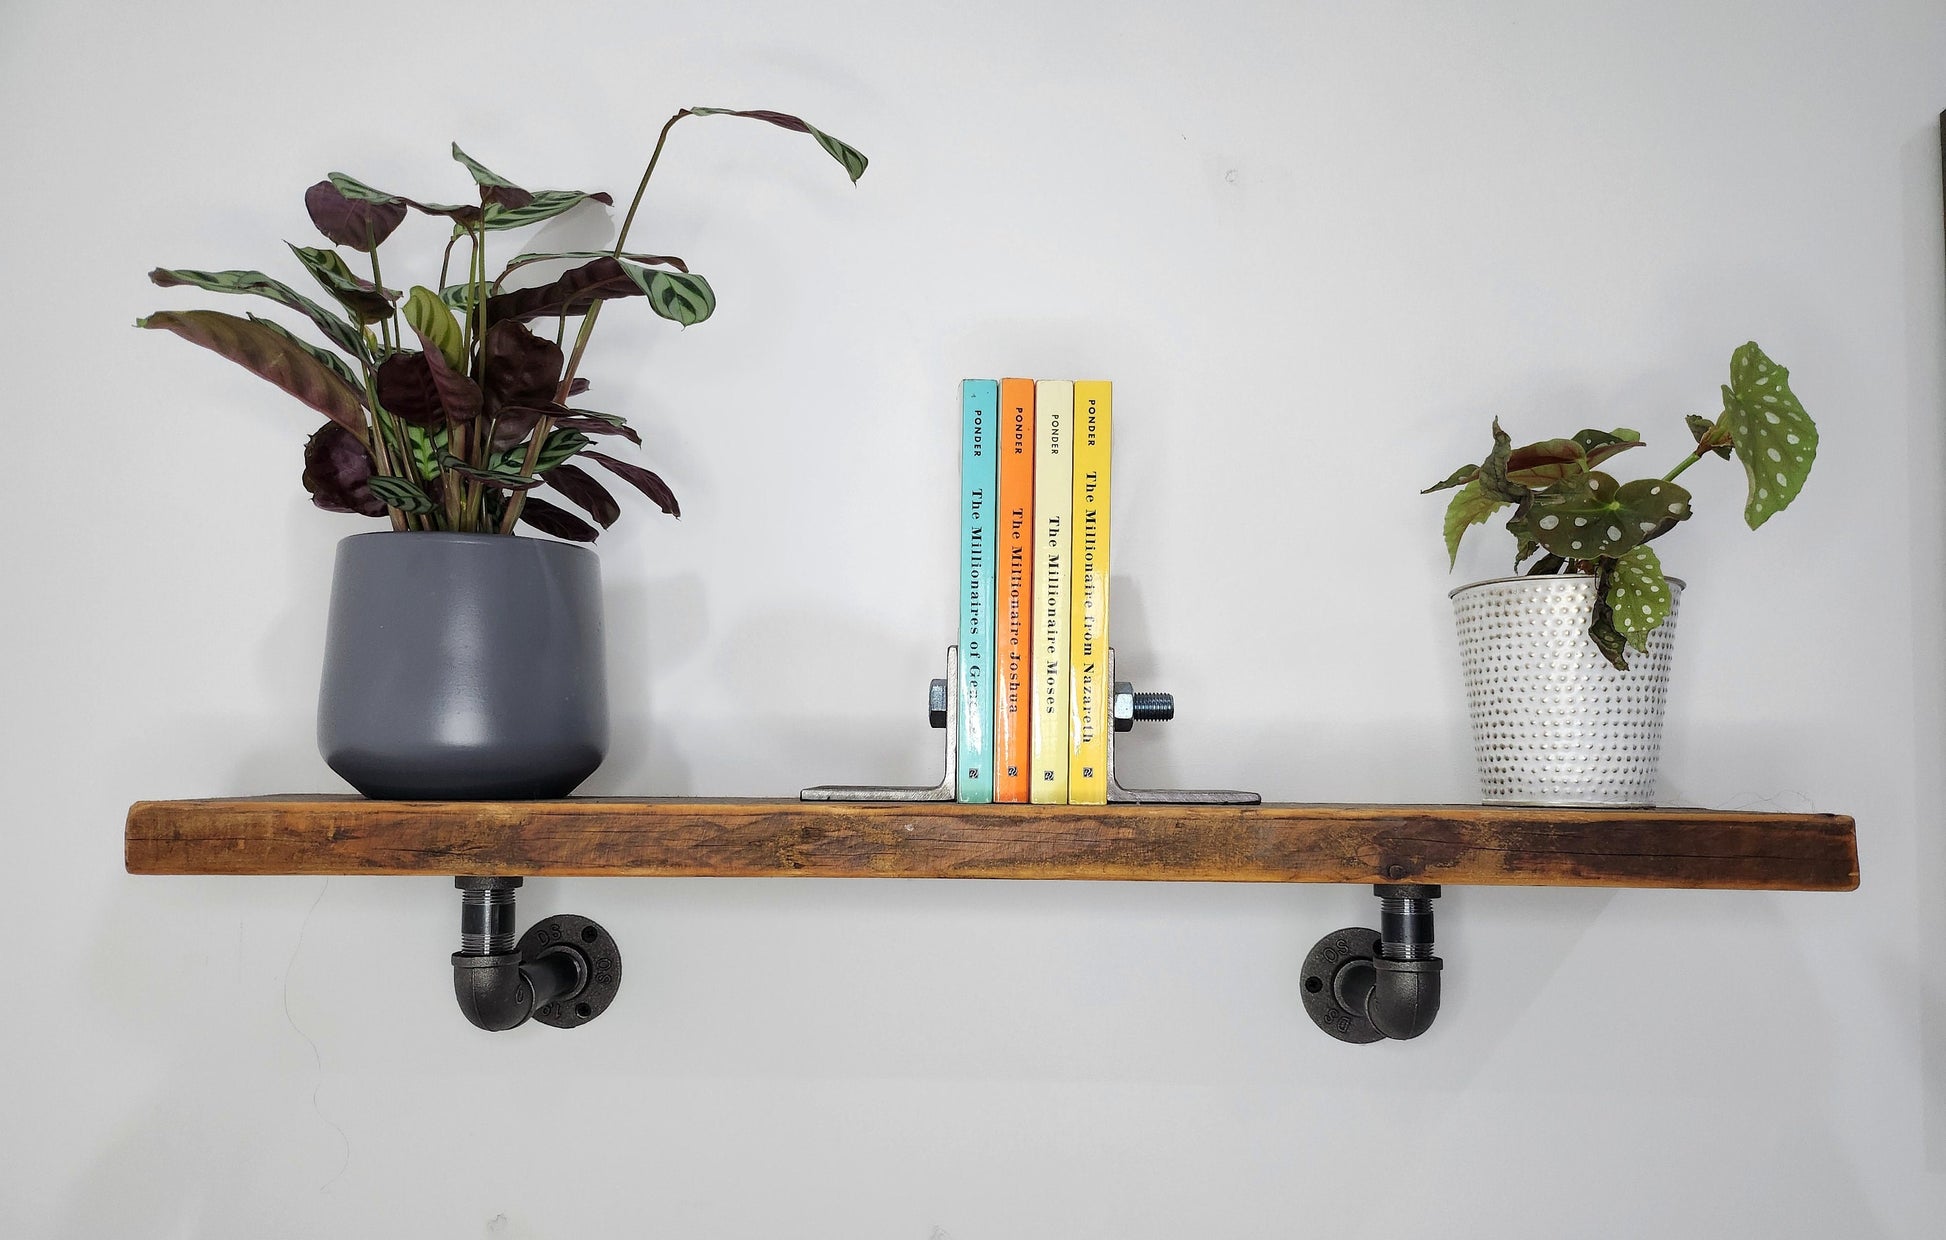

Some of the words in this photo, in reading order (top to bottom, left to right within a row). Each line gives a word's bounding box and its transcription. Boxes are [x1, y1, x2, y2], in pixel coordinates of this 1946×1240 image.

[973, 410, 982, 457] PONDER
[1014, 407, 1023, 454] PONDER
[1051, 414, 1060, 455] PONDER
[1087, 399, 1096, 446] PONDER
[971, 488, 983, 520] The
[1085, 471, 1097, 503] The
[1011, 508, 1024, 540] The
[1048, 516, 1060, 548] The
[970, 526, 982, 635] Millionaires
[1084, 509, 1096, 608] Millionaire
[1010, 546, 1023, 645] Millionaire
[1047, 554, 1059, 654] Millionaire
[969, 641, 981, 659] of
[1083, 615, 1095, 656] from
[1009, 650, 1021, 713] Joshua
[1046, 661, 1058, 714] Moses
[1082, 663, 1095, 743] Nazareth
[537, 923, 561, 947] DS
